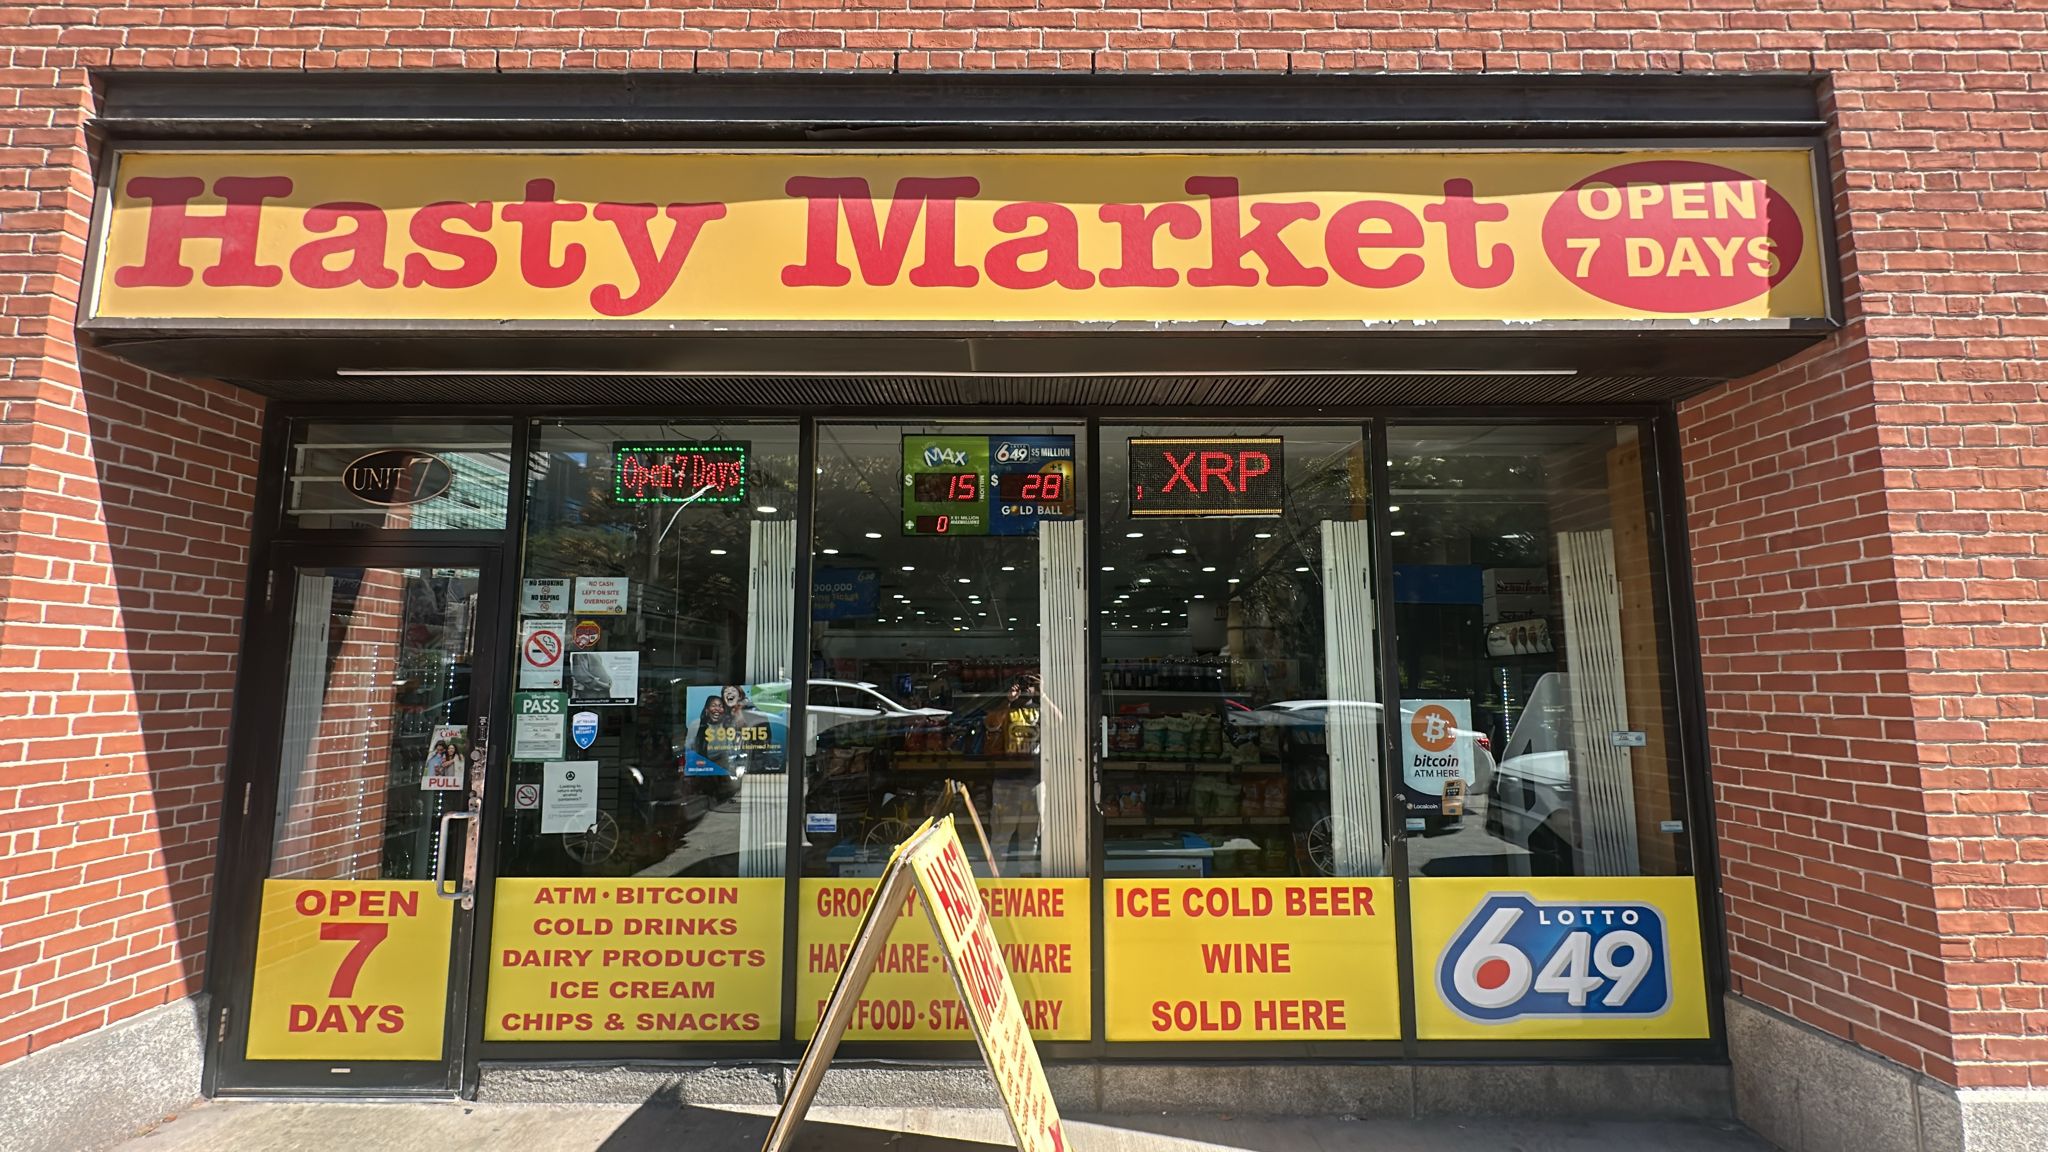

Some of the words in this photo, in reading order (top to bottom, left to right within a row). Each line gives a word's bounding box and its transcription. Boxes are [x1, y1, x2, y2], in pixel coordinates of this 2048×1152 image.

[1577, 181, 1757, 220] OPEN
[114, 176, 727, 316] Hasty
[781, 176, 1515, 289] Market
[1566, 237, 1600, 278] 7
[1625, 236, 1781, 278] DAYS
[997, 444, 1028, 462] 649
[1031, 447, 1040, 457] $5
[1041, 447, 1071, 457] MILLION
[352, 467, 406, 490] UNIT
[409, 457, 433, 497] 7
[623, 456, 673, 497] Open
[675, 454, 688, 488] 7
[692, 454, 740, 492] Days
[1162, 451, 1271, 493] XRP
[905, 474, 913, 487] $
[948, 474, 975, 500] 15
[990, 474, 999, 487] $
[1022, 474, 1062, 500] 28
[1037, 505, 1063, 515] BALL
[937, 516, 949, 533] 0
[522, 699, 560, 714] PASS
[704, 726, 768, 742] $99,515
[1414, 754, 1459, 768] bitcoin
[1414, 769, 1434, 778] ATM
[1436, 769, 1460, 778] HERE
[428, 778, 460, 788] PULL
[295, 889, 419, 917] OPEN
[534, 887, 596, 904] ATM
[616, 887, 738, 904] BITCOIN
[1115, 887, 1171, 917] ICE
[1182, 887, 1273, 917] COLD
[1285, 886, 1376, 916] BEER
[533, 918, 613, 936] COLD
[623, 918, 738, 936] DRINKS
[1538, 909, 1640, 925] LOTTO
[319, 922, 389, 999] 7
[502, 949, 593, 967] DAIRY
[602, 949, 766, 967] PRODUCTS
[1201, 943, 1291, 973] WINE
[1453, 907, 1653, 1009] 649
[550, 981, 599, 999] ICE
[609, 981, 715, 999] CREAM
[288, 1004, 405, 1034] DAYS
[501, 1013, 593, 1031] CHIPS
[604, 1013, 625, 1031] &
[636, 1013, 760, 1031] SNACKS
[1151, 1000, 1242, 1031] SOLD
[1254, 1000, 1347, 1031] HERE
